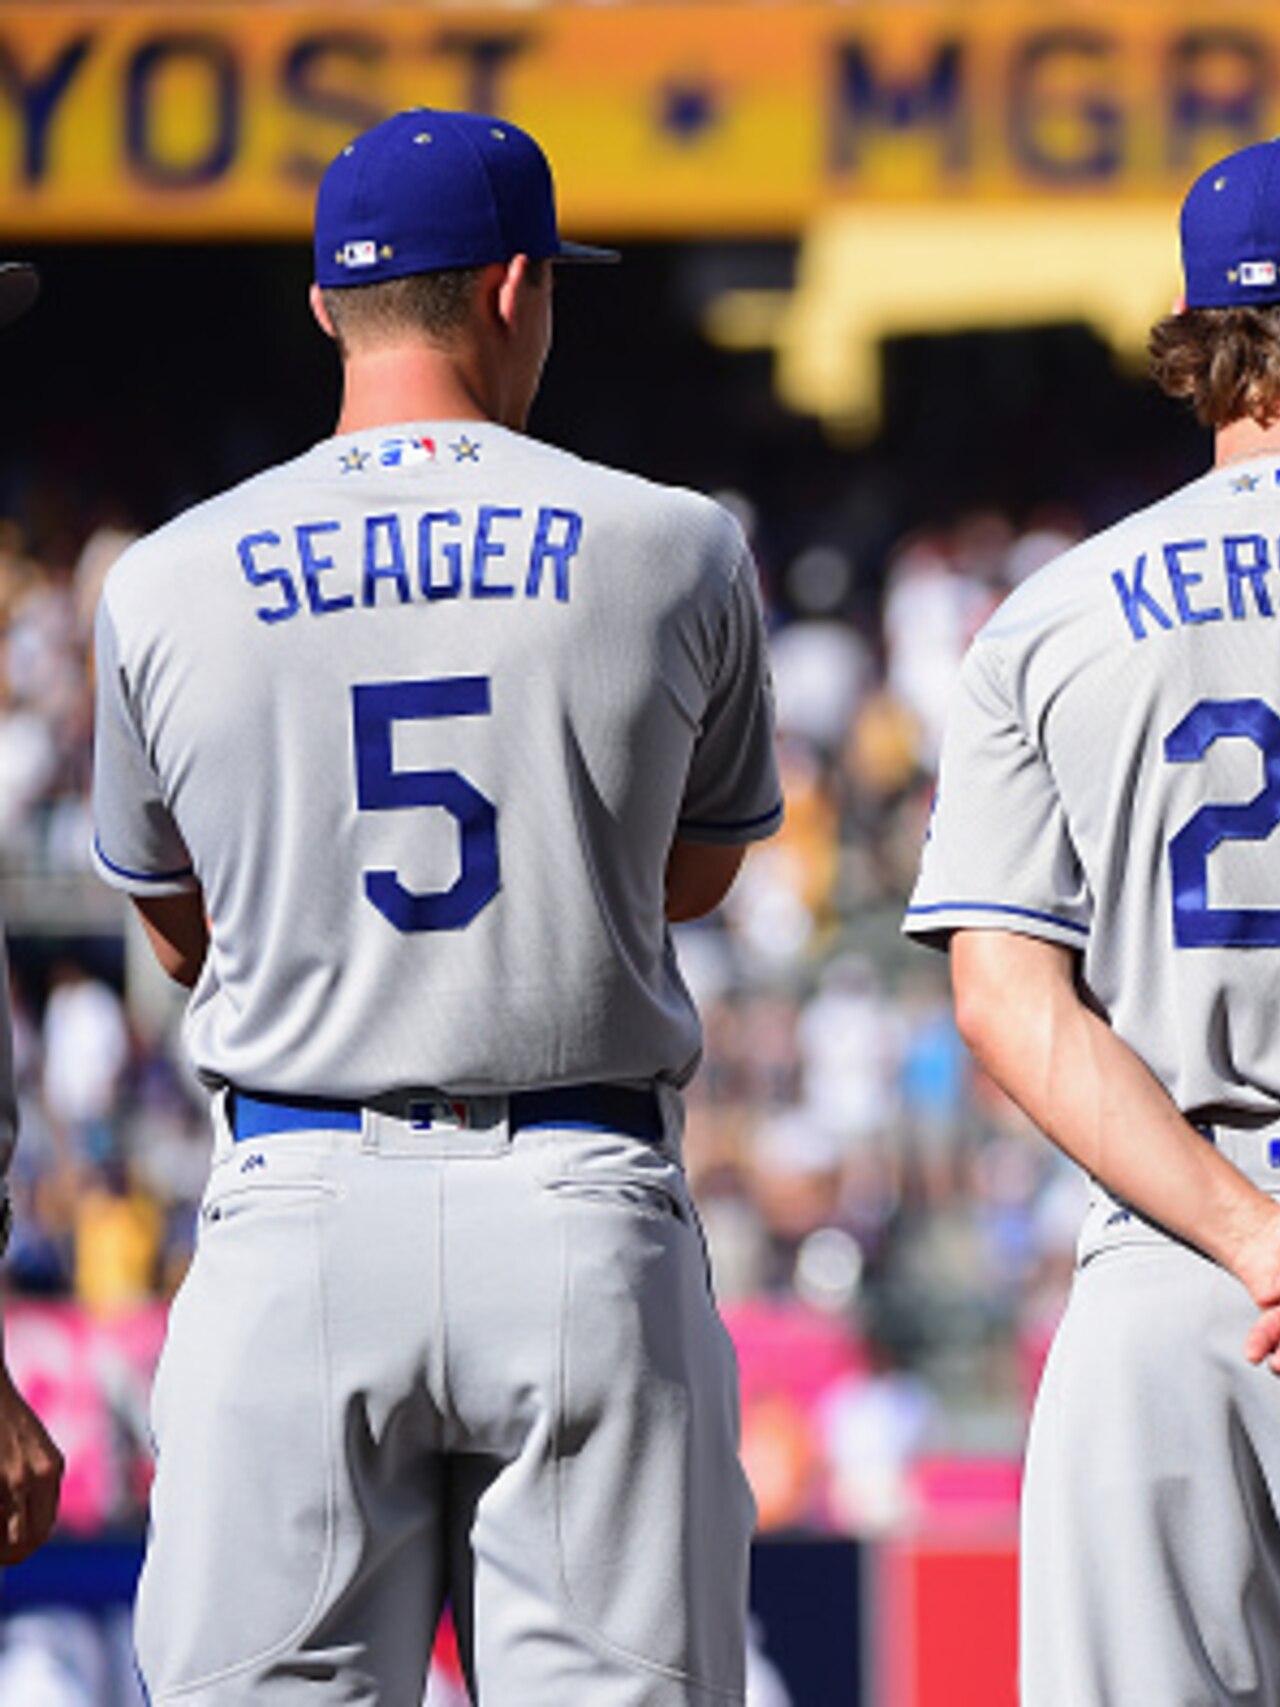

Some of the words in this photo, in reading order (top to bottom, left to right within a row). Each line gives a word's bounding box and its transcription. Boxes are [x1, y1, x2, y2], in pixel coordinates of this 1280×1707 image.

[0, 28, 538, 188] YOST
[828, 26, 1278, 188] MGR
[237, 506, 583, 624] SEAGER
[351, 675, 502, 934] 5
